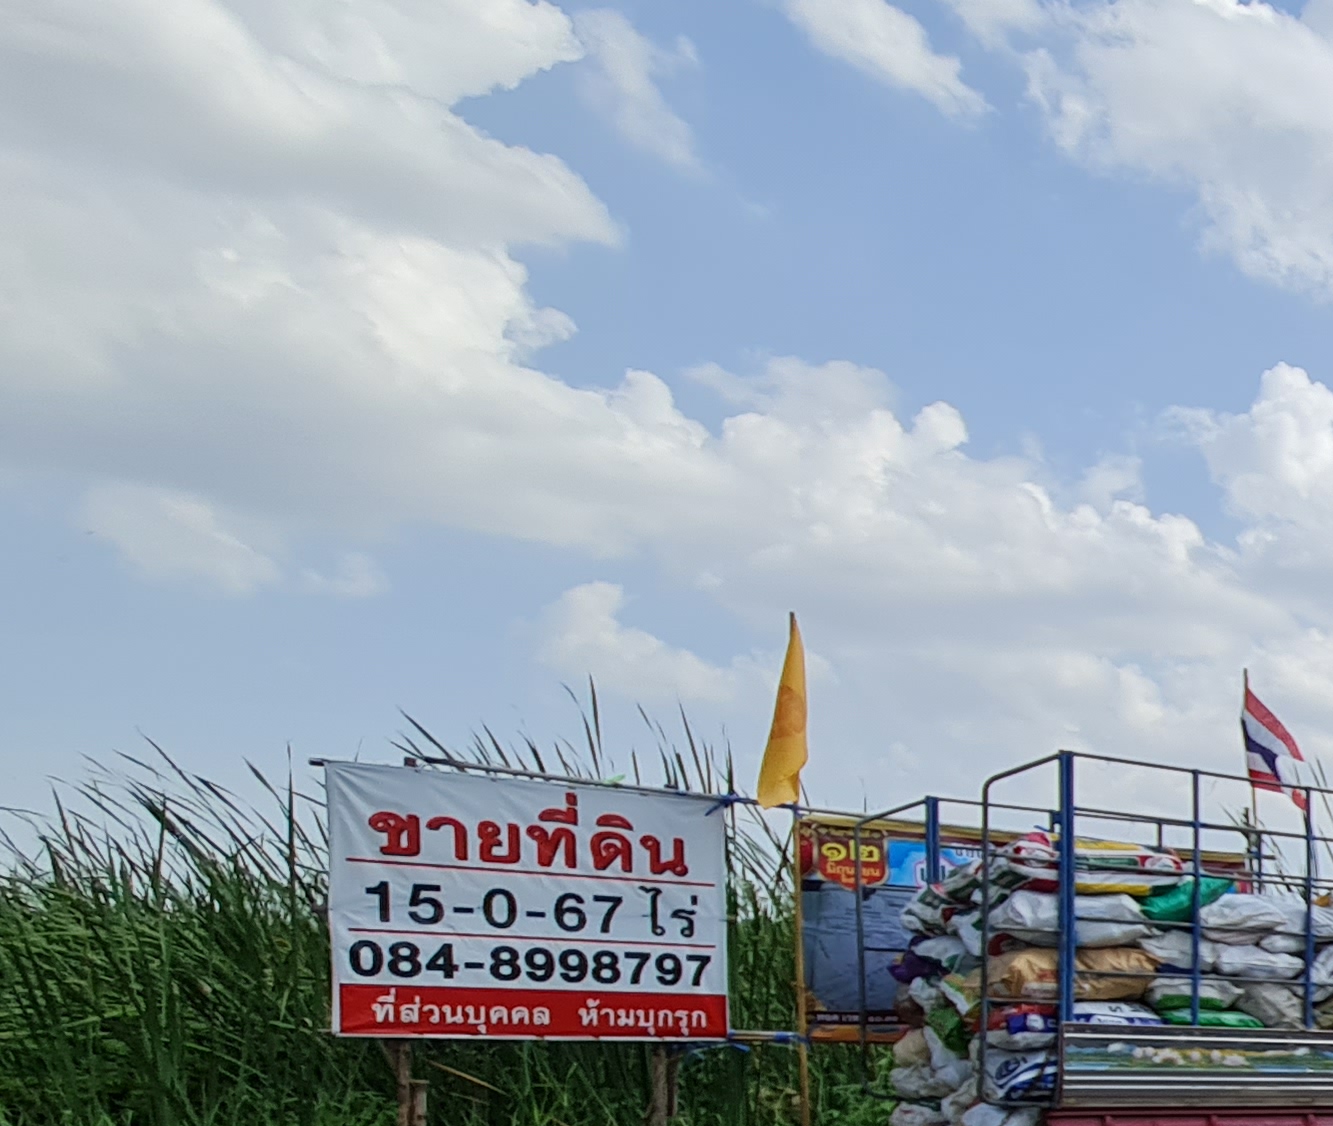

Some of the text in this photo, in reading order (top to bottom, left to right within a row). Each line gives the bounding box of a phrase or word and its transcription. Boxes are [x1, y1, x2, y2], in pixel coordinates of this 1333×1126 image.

[368, 792, 689, 877] ขายที่ดิน
[364, 880, 699, 938] 15-0-67 ไร่
[347, 938, 713, 988] 084-8998797
[371, 987, 708, 1037] ที่ส่วนบุคคล ห้ามบุกรุก
